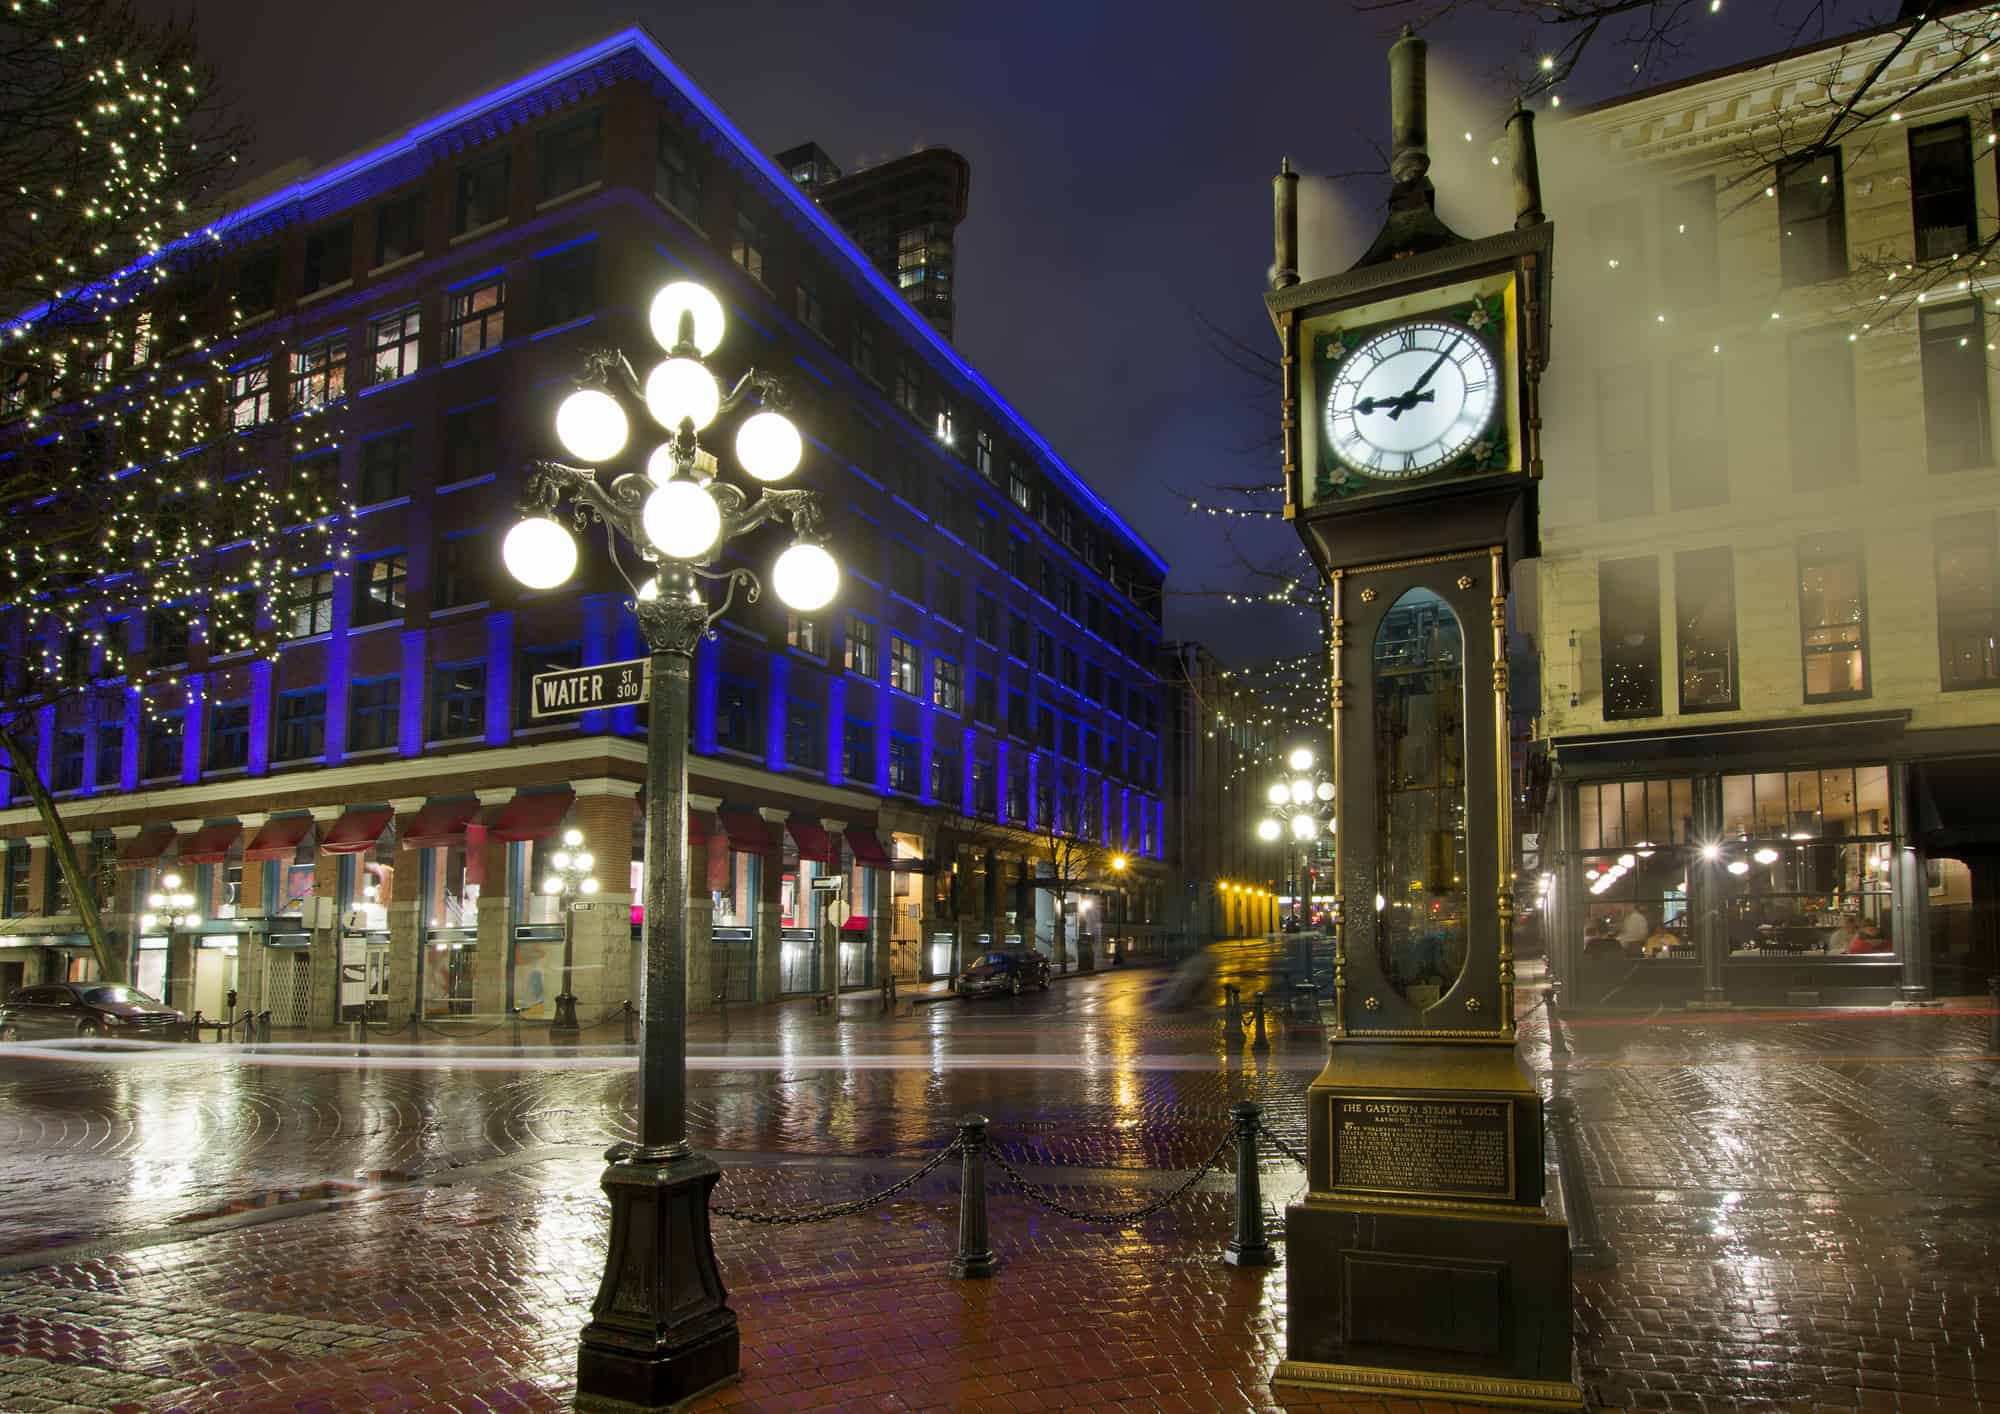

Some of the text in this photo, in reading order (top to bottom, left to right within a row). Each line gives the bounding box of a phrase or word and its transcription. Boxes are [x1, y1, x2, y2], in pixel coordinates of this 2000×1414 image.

[622, 670, 633, 684] ST
[543, 674, 603, 708] WATER
[617, 683, 638, 698] 300
[1343, 1104, 1362, 1113] THE
[1366, 1104, 1418, 1114] GASTOWN
[1422, 1105, 1457, 1115] STEAM
